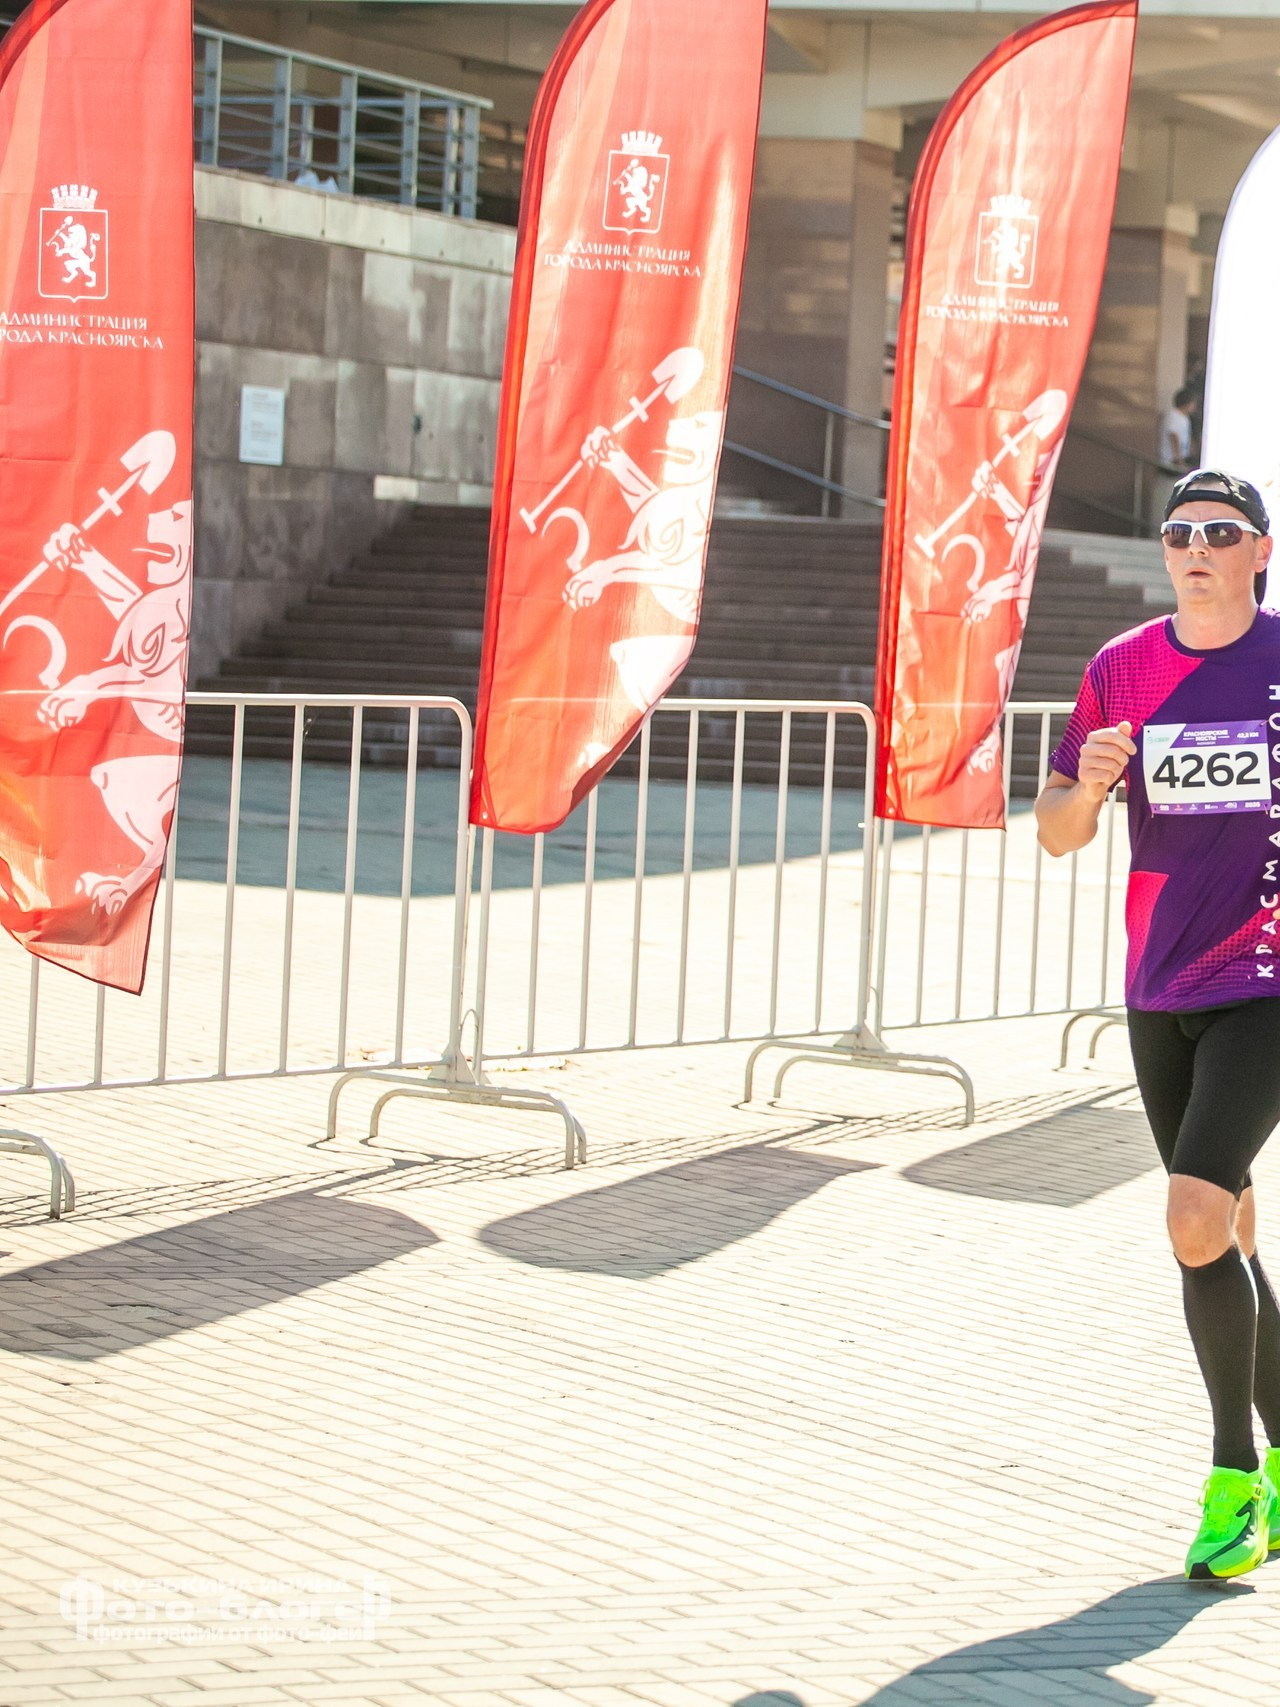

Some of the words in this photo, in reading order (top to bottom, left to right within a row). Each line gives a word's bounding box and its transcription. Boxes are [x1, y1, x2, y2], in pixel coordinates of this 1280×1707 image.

[563, 240, 691, 261] АДМИНИСТРАЦИЯ
[544, 254, 602, 271] ГОРОДА
[605, 258, 702, 278] КРАСНОЯРСКА
[0, 312, 148, 331] АДМИНИСТРАЦИЯ
[48, 331, 164, 350] КРАСНОЯРСКА
[1152, 751, 1261, 789] 4262
